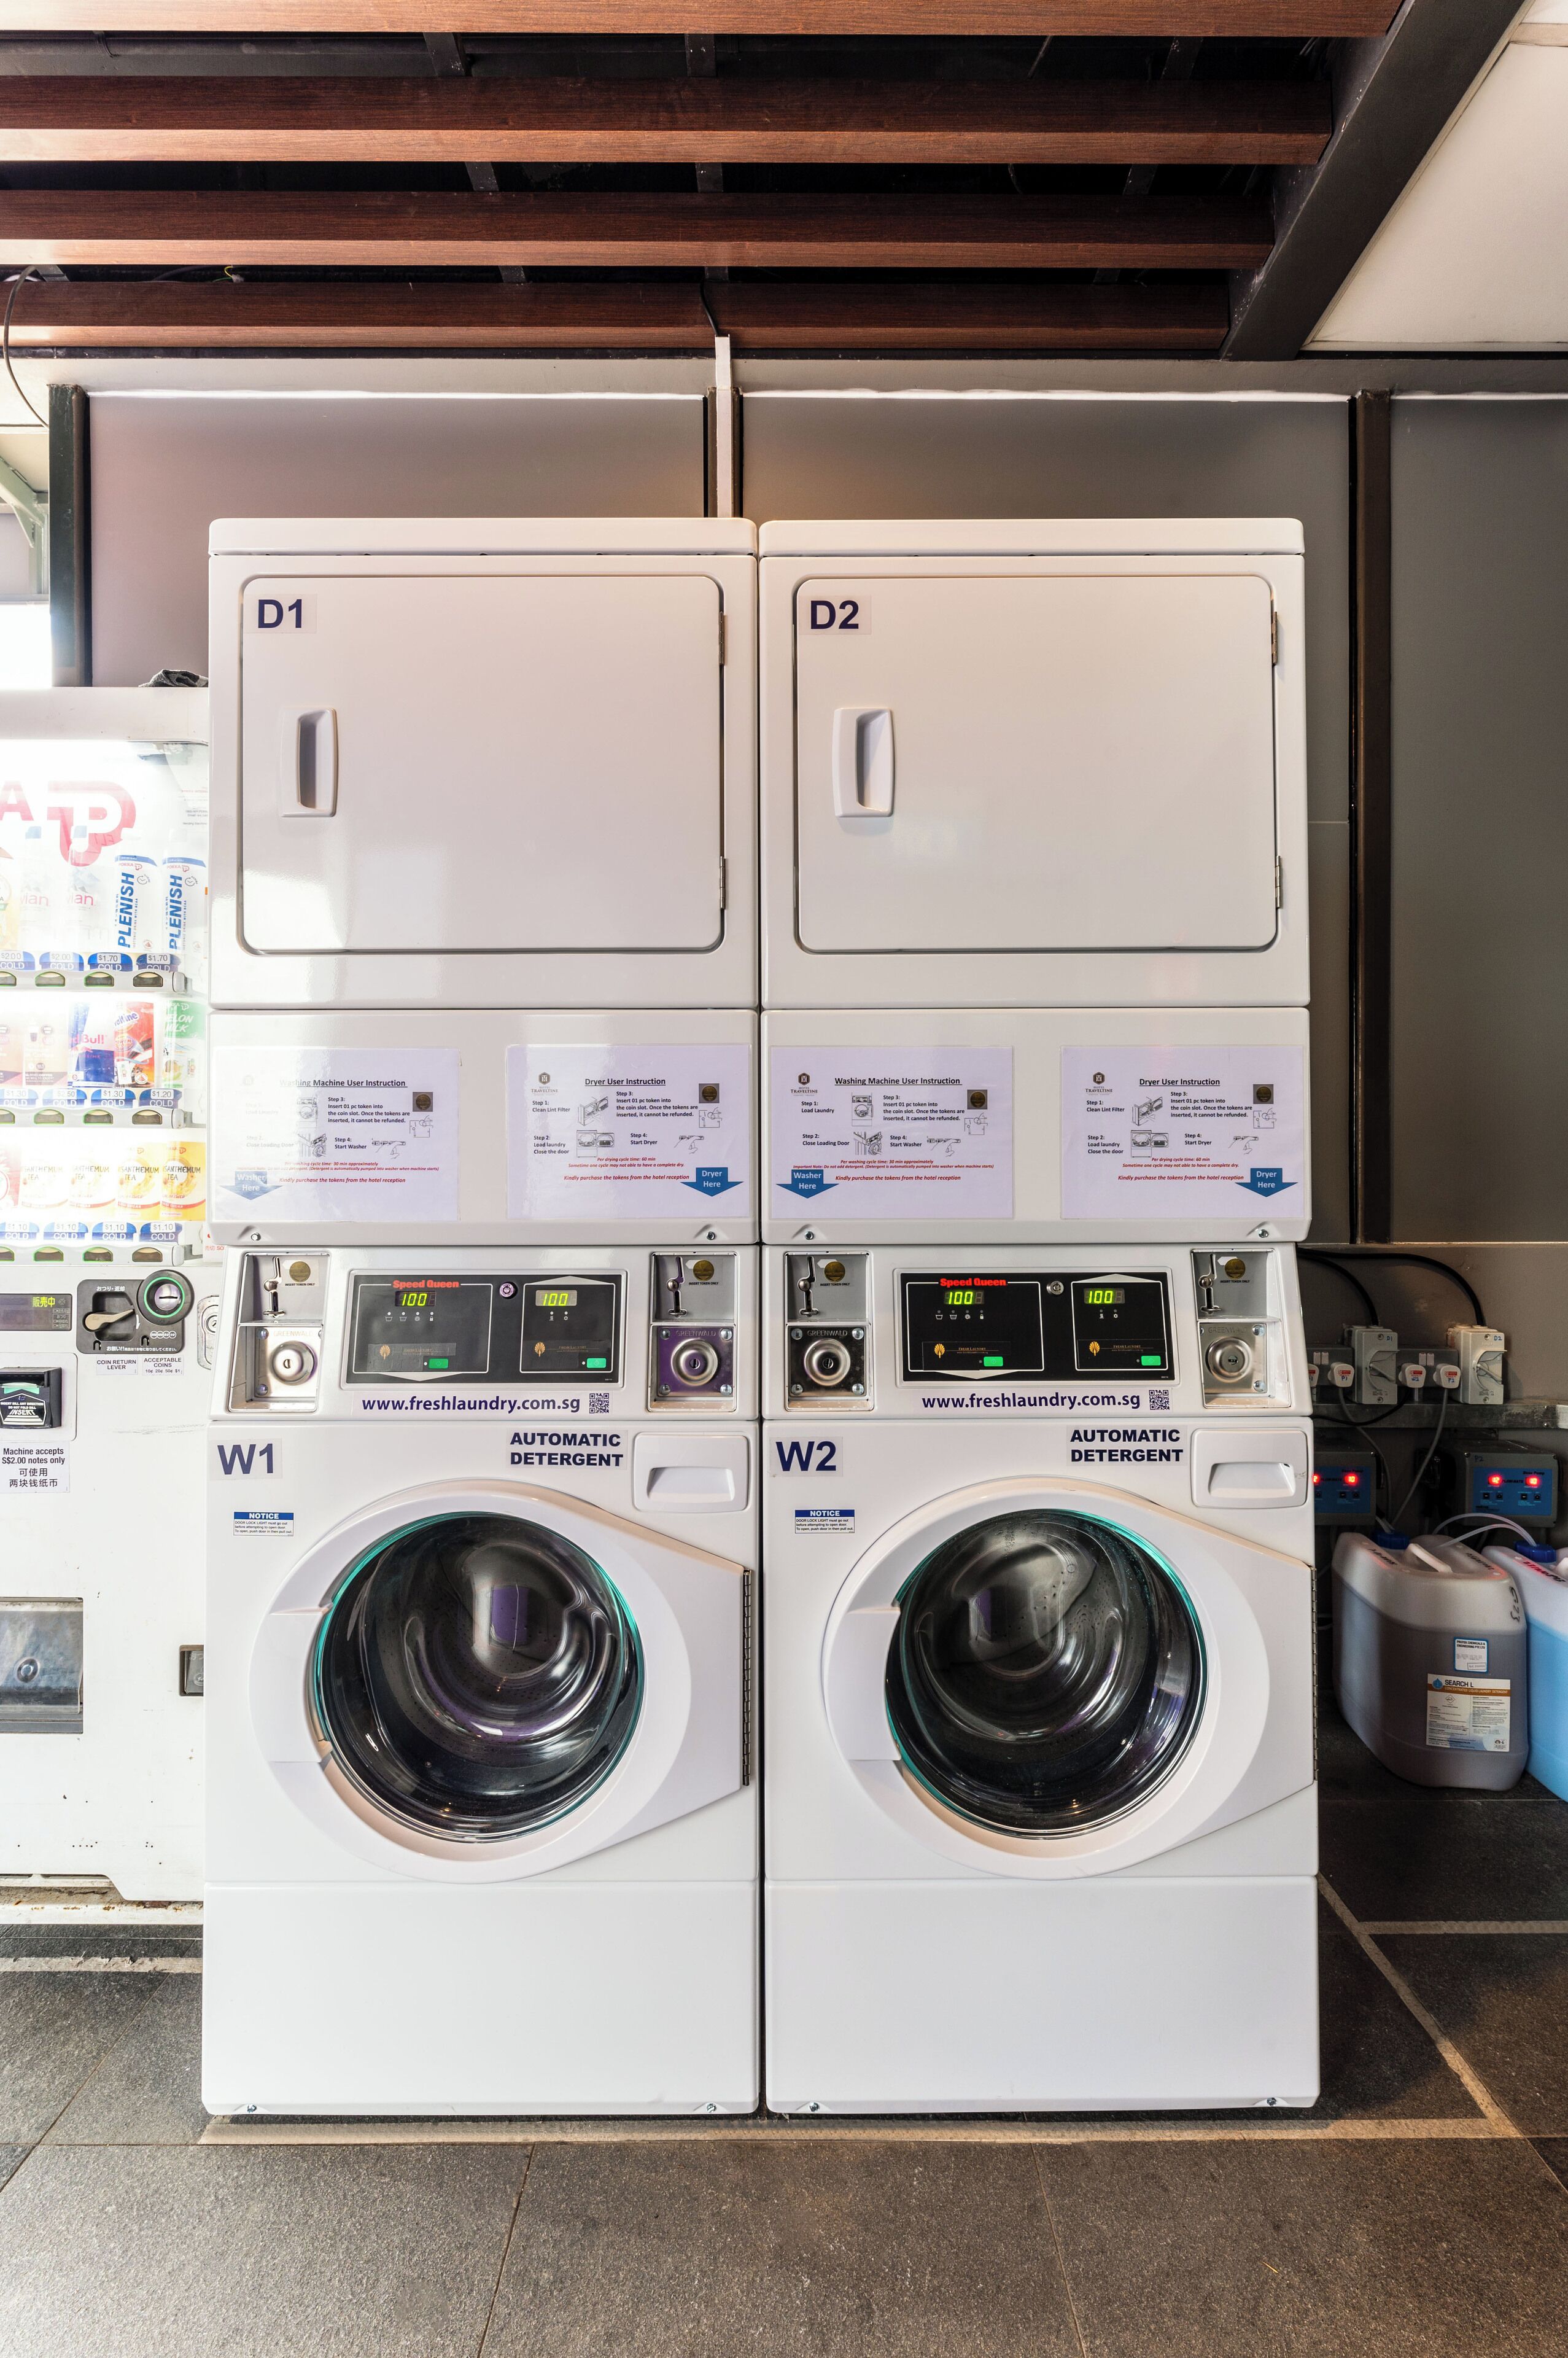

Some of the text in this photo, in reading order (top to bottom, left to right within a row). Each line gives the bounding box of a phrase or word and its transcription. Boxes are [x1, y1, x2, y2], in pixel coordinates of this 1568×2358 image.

[257, 599, 303, 629] D1
[811, 600, 859, 630] D2
[118, 873, 134, 947] PLENISH
[169, 875, 182, 949] PLENISH
[98, 954, 118, 962] $1.70
[393, 1280, 425, 1289] Speed
[941, 1278, 1007, 1287] Speed Queen
[33, 1297, 55, 1307] 販売中
[400, 1293, 427, 1306] 100
[543, 1293, 569, 1306] 100
[949, 1291, 972, 1304] 100
[1089, 1291, 1113, 1304] 100
[362, 1396, 580, 1414] www.freshlaundry.com.sg
[922, 1392, 1140, 1409] www.freshlaundry.com.sg
[510, 1432, 621, 1447] AUTOMATIC
[1071, 1430, 1181, 1443] AUTOMATIC
[36, 1448, 63, 1457] accepts
[217, 1444, 274, 1474] W1
[510, 1452, 623, 1466] DETERGENT
[776, 1441, 836, 1471] W2
[1071, 1449, 1184, 1462] DETERGENT
